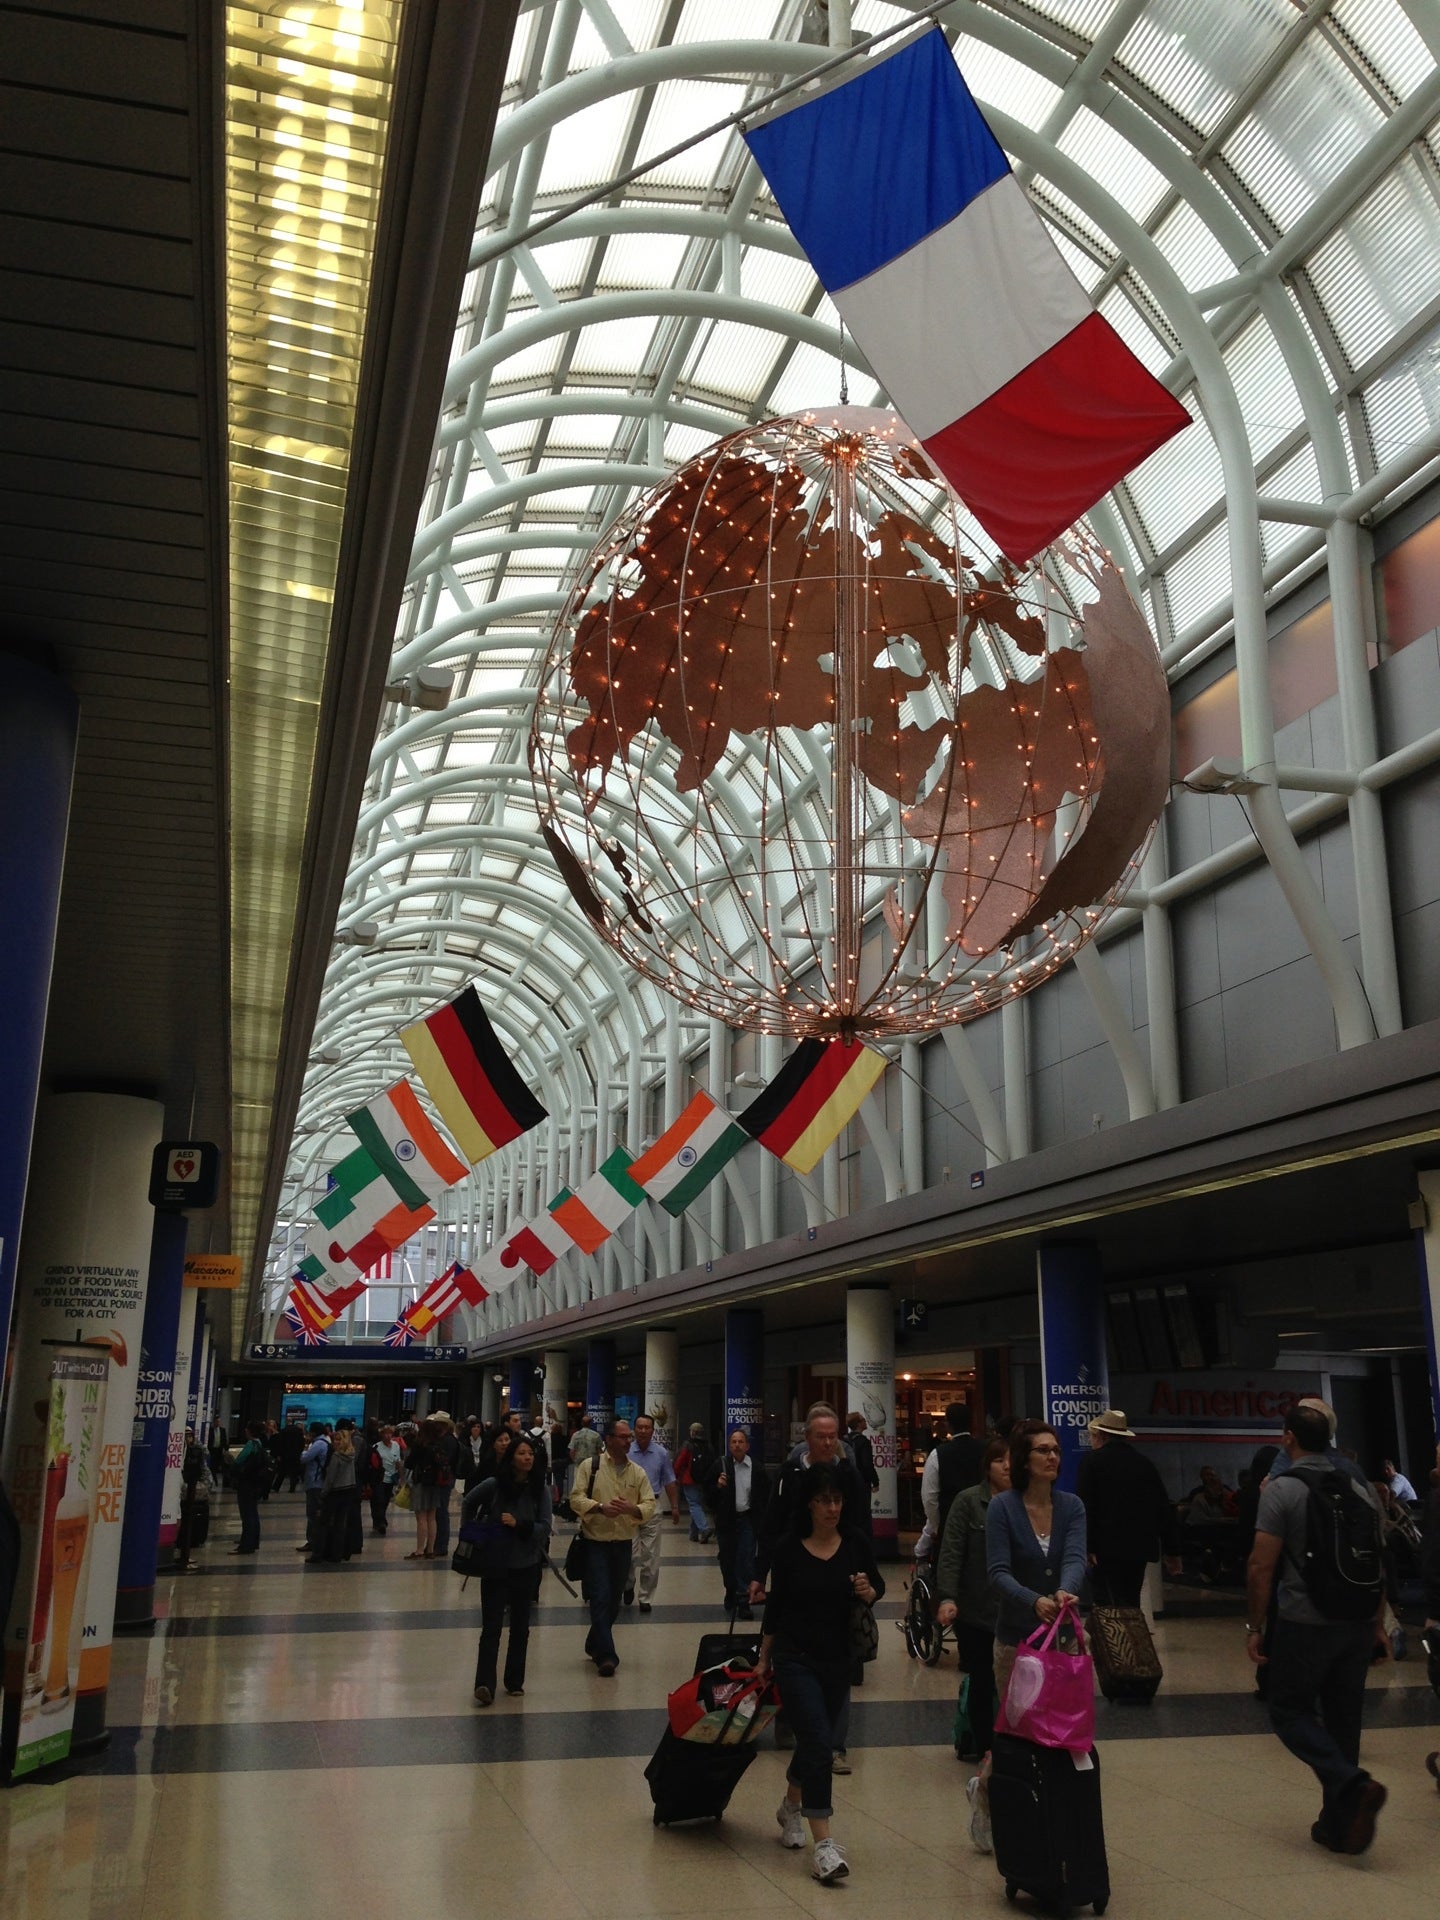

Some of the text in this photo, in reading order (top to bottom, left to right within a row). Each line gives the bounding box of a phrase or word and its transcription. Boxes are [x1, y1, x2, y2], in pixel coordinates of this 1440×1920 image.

[46, 1265, 140, 1278] GRIND VIRTUALLY ANY
[44, 1277, 139, 1289] KIND OF FOOD WASTE
[53, 1287, 67, 1297] AN
[69, 1287, 119, 1298] UNENDING
[120, 1289, 143, 1300] SOURCE
[54, 1298, 109, 1308] ELECTRICAL
[110, 1299, 137, 1310] POWER
[65, 1309, 85, 1318] FOR
[86, 1309, 94, 1318] A
[89, 1363, 105, 1376] OLD
[1150, 1379, 1321, 1419] America
[1052, 1413, 1064, 1427] IT
